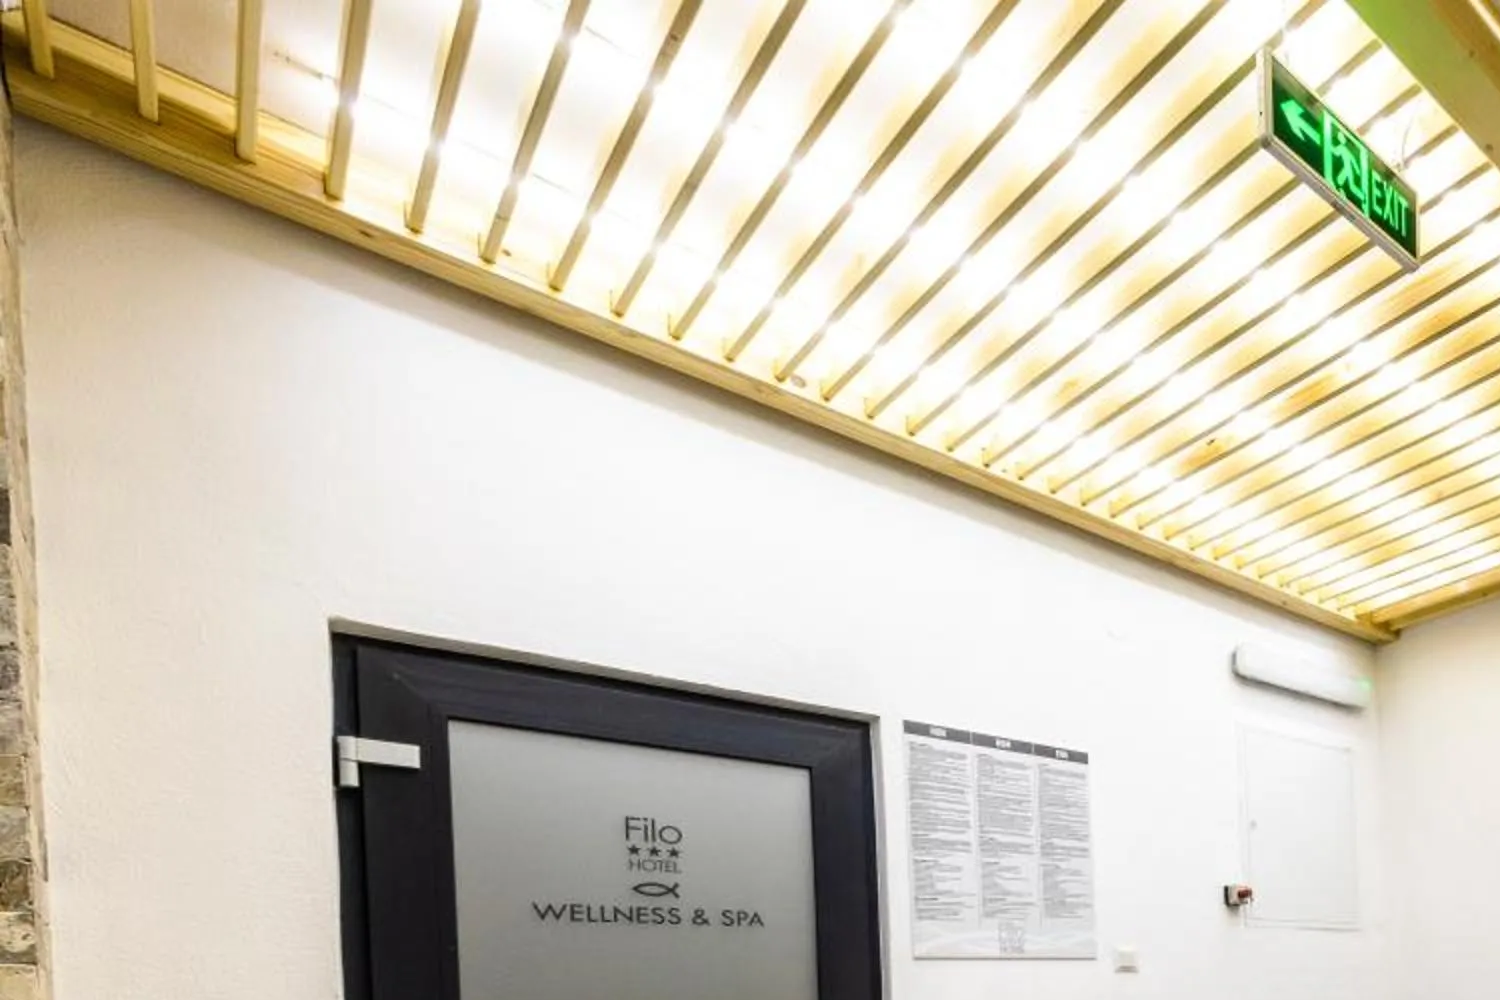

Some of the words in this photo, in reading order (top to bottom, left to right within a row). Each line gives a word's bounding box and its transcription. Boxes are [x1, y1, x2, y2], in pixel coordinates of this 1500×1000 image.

[1371, 169, 1409, 237] EXIT
[625, 816, 683, 845] Filo
[628, 858, 682, 874] HOTEL
[532, 902, 682, 925] WELLNESS
[692, 908, 711, 926] &
[721, 909, 765, 928] SPA
